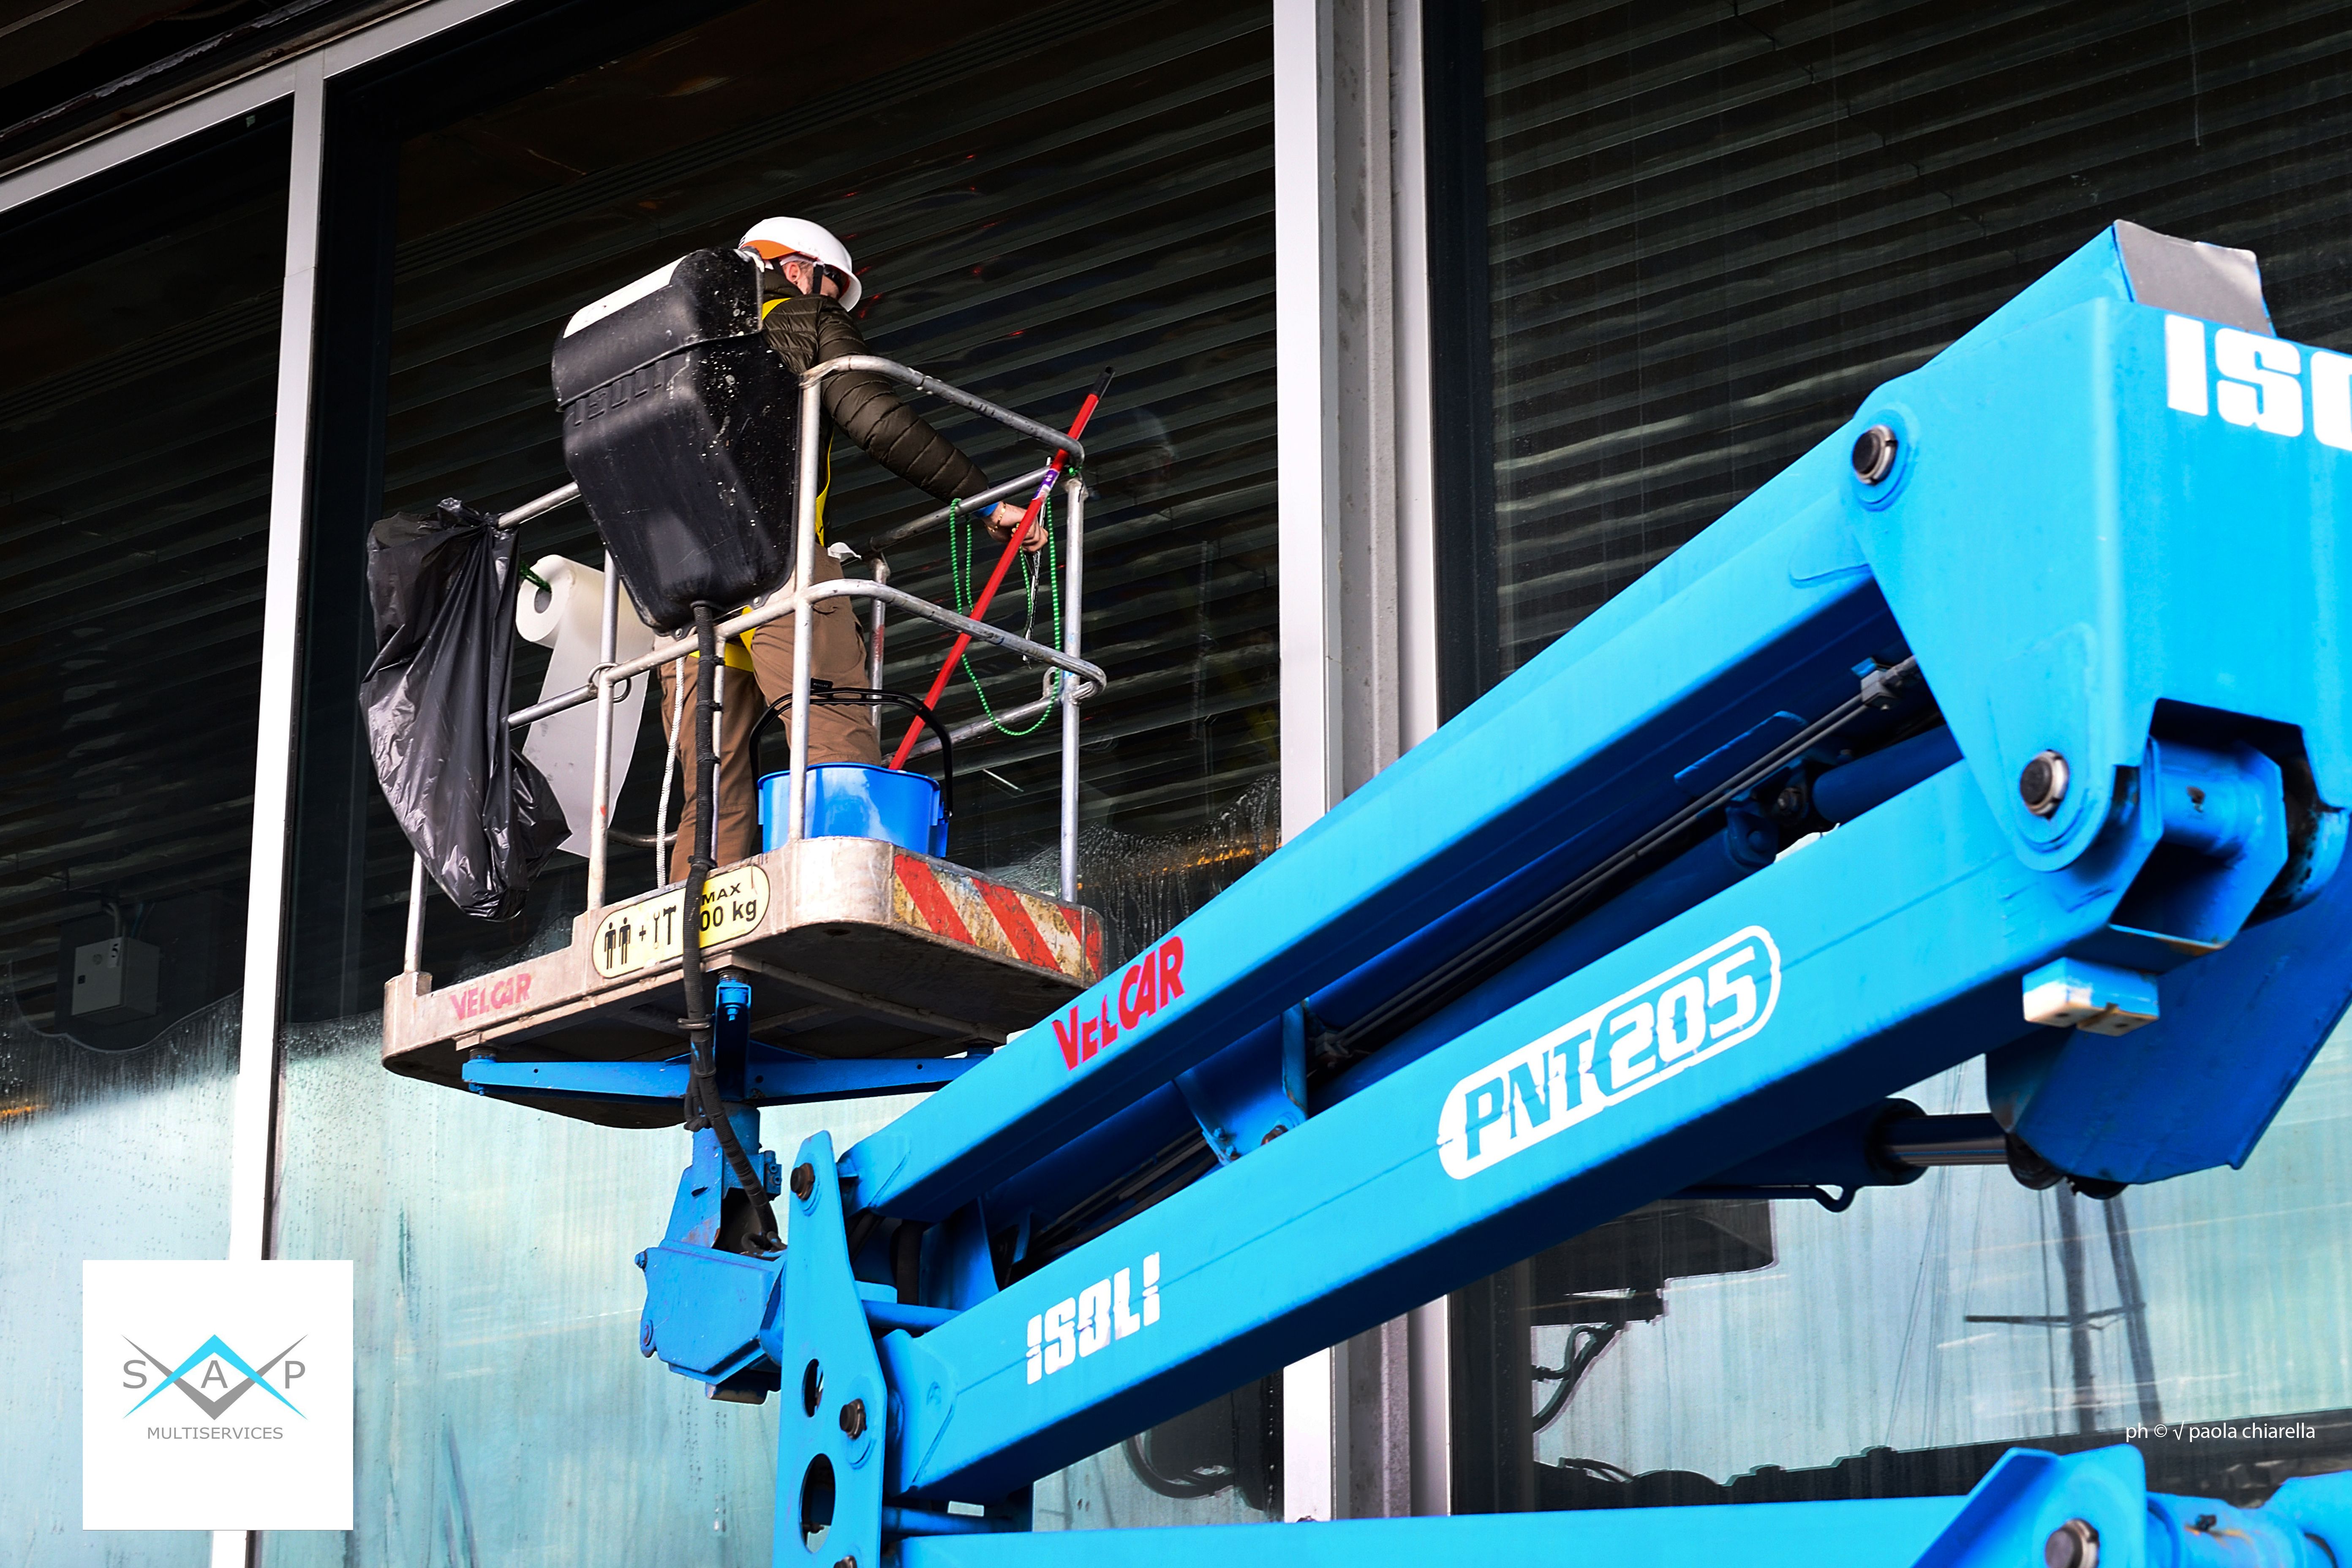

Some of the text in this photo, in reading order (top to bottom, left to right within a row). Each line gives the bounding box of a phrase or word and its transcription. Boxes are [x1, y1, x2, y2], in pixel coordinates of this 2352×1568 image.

[702, 882, 741, 906] MAX
[732, 900, 757, 922] kg
[450, 973, 531, 1021] VELCAR
[1026, 1251, 1160, 1385] ISOLI
